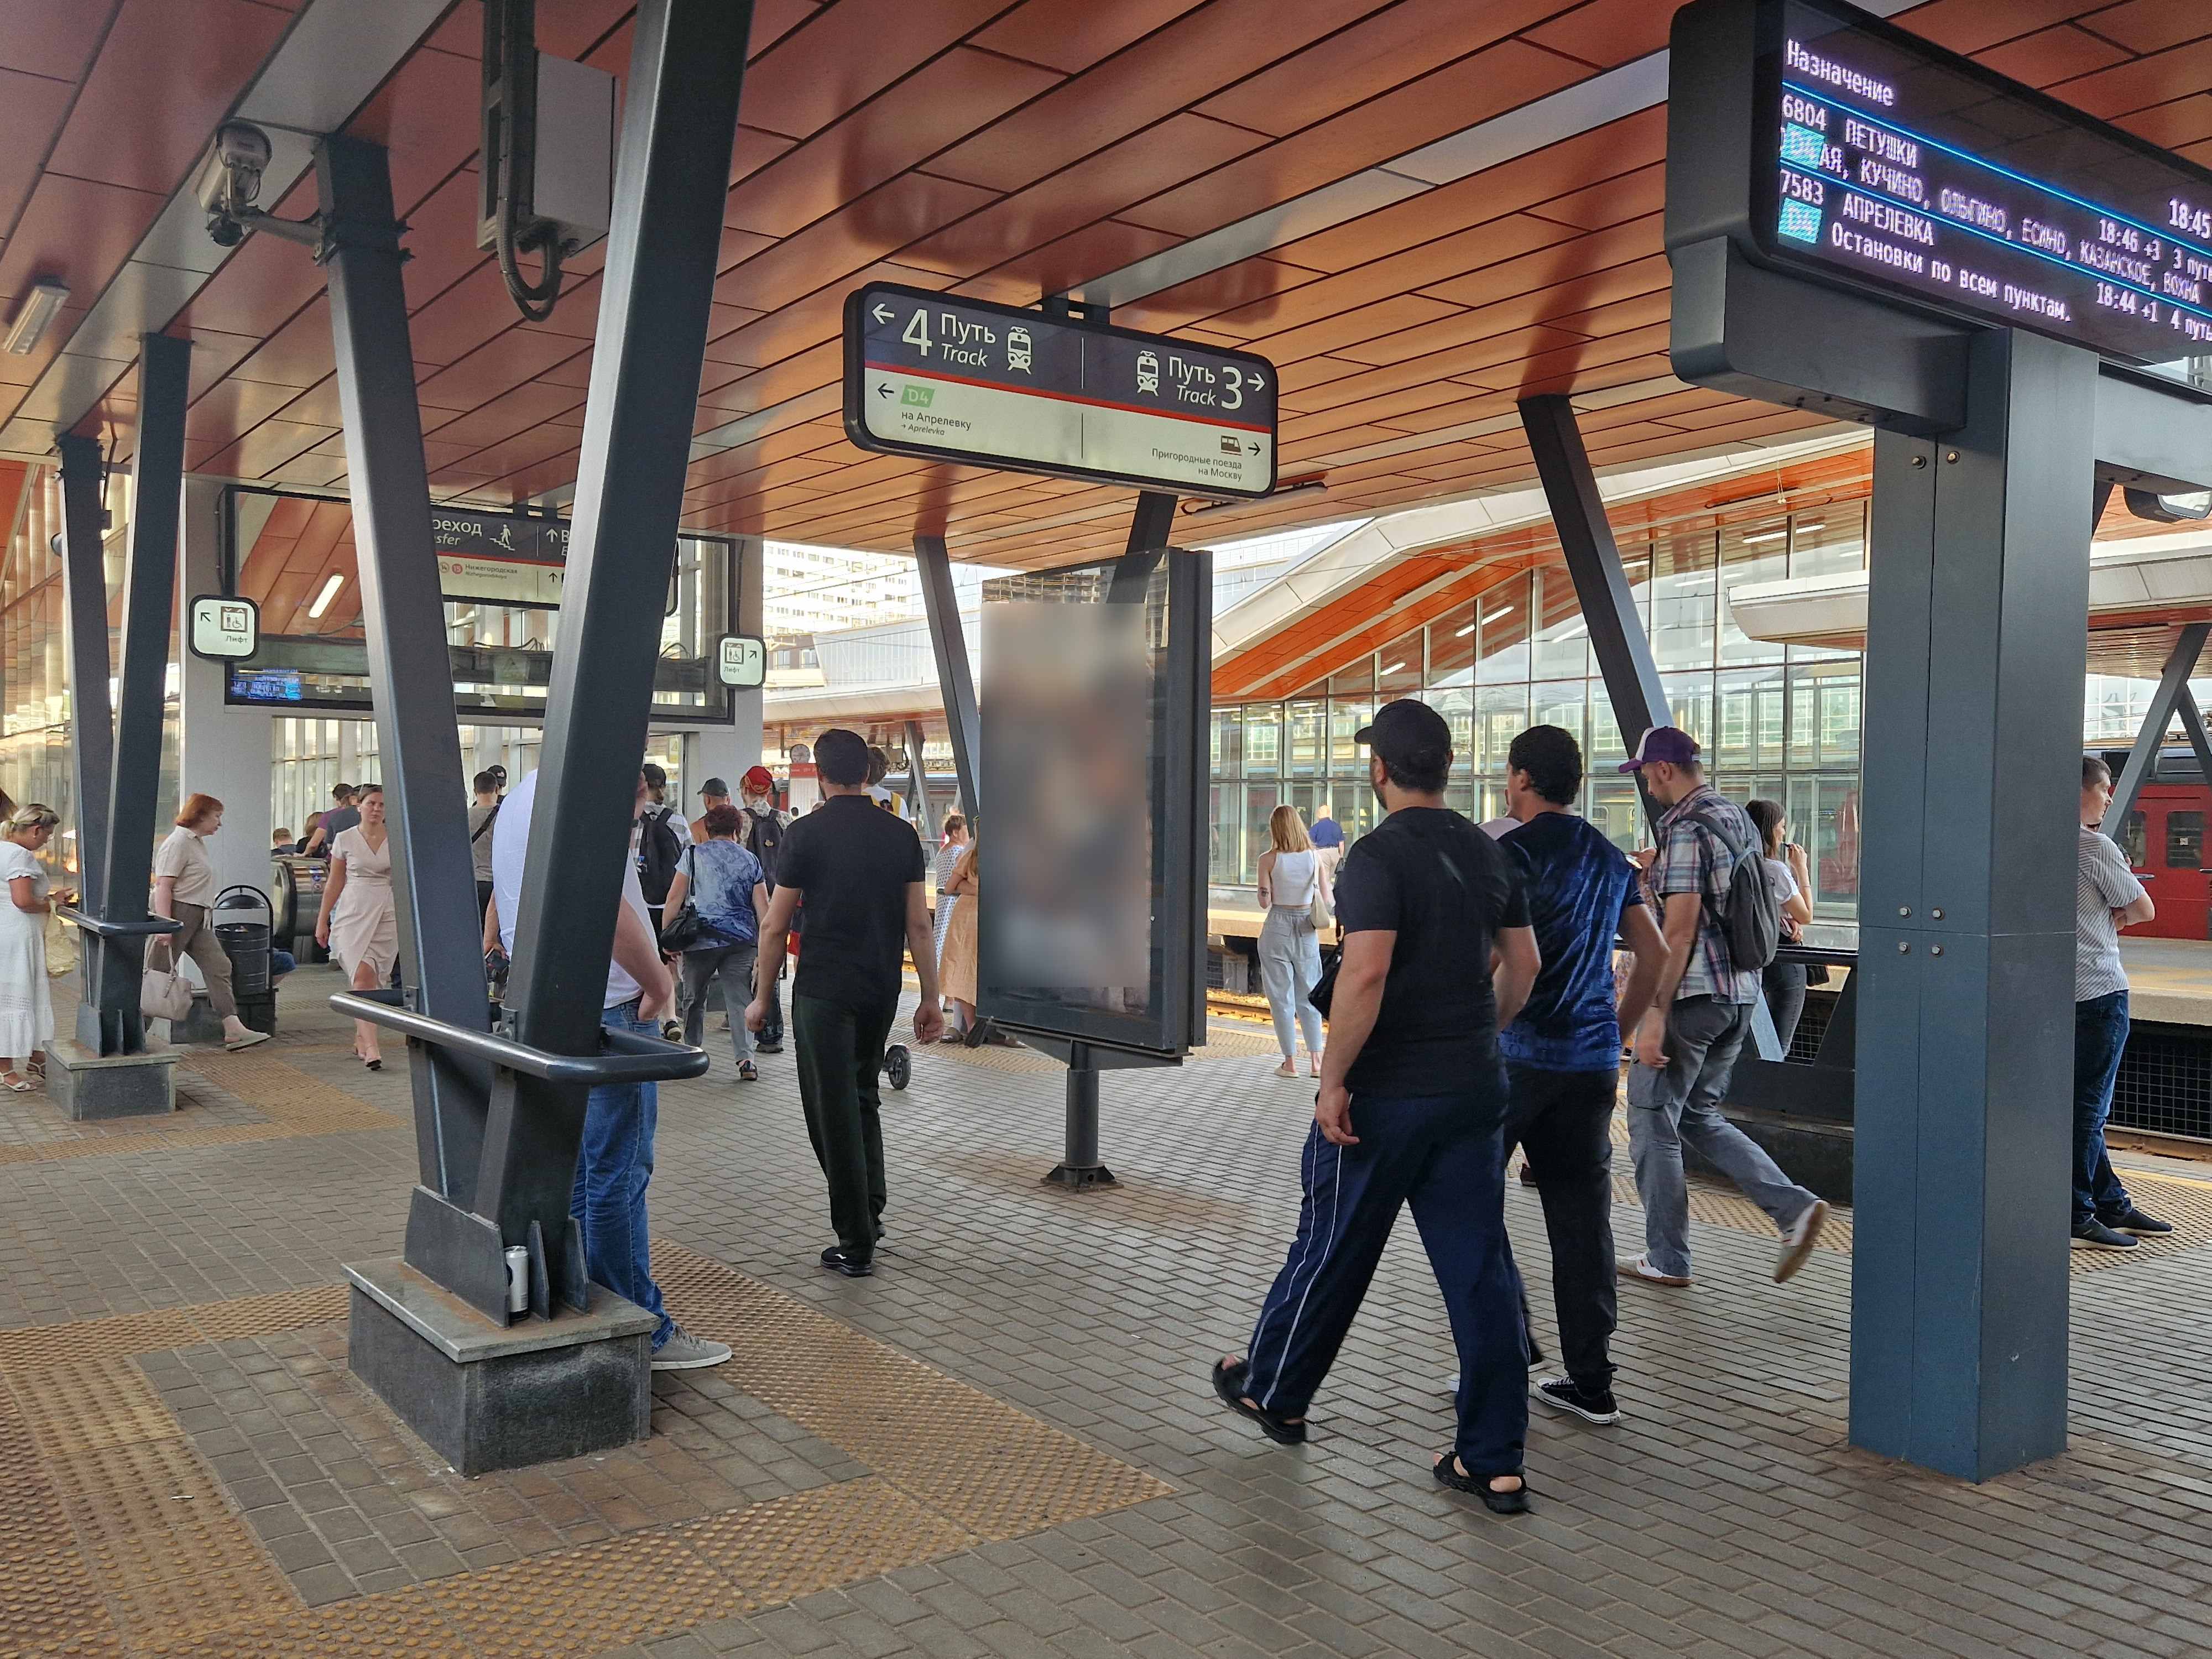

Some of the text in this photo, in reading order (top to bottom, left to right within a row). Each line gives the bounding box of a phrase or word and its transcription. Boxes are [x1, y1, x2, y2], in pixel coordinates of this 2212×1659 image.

[1787, 38, 2211, 239] Назначение 18:45
[1782, 93, 1827, 131] 6804
[1845, 118, 1918, 169] ПЕТУШКИ
[2099, 218, 2140, 253] 18:46
[2143, 239, 2162, 261] +3
[2173, 247, 2183, 269] 3
[1860, 158, 1930, 210] КУЧИНО,
[1940, 187, 2013, 241] ОЛЬГИНО,
[2021, 217, 2072, 261] ЕСИНО,
[2079, 239, 2157, 293] КАЗАНСКОЕ,
[2163, 271, 2201, 305] ВОХНА
[1780, 169, 1824, 205] 7583
[1843, 192, 1934, 247] АПРЕЛЕВКА
[2096, 282, 2137, 315] 18:44
[2141, 300, 2159, 323] +1
[2170, 309, 2181, 330] 4
[1832, 221, 2072, 322] Остановки по всем пунктам.
[902, 309, 996, 357] 4 Путь
[941, 342, 989, 368] Track
[1169, 356, 1243, 410] Путь 3
[1177, 384, 1217, 406] Track
[907, 388, 929, 405] D4
[901, 411, 972, 431] на Апрелевку
[908, 424, 945, 436] Aprelevka
[1152, 448, 1242, 469] Пригородные поезда
[1211, 468, 1242, 482] Москву
[465, 563, 518, 574] Нижегородская
[226, 635, 248, 644] Лифт
